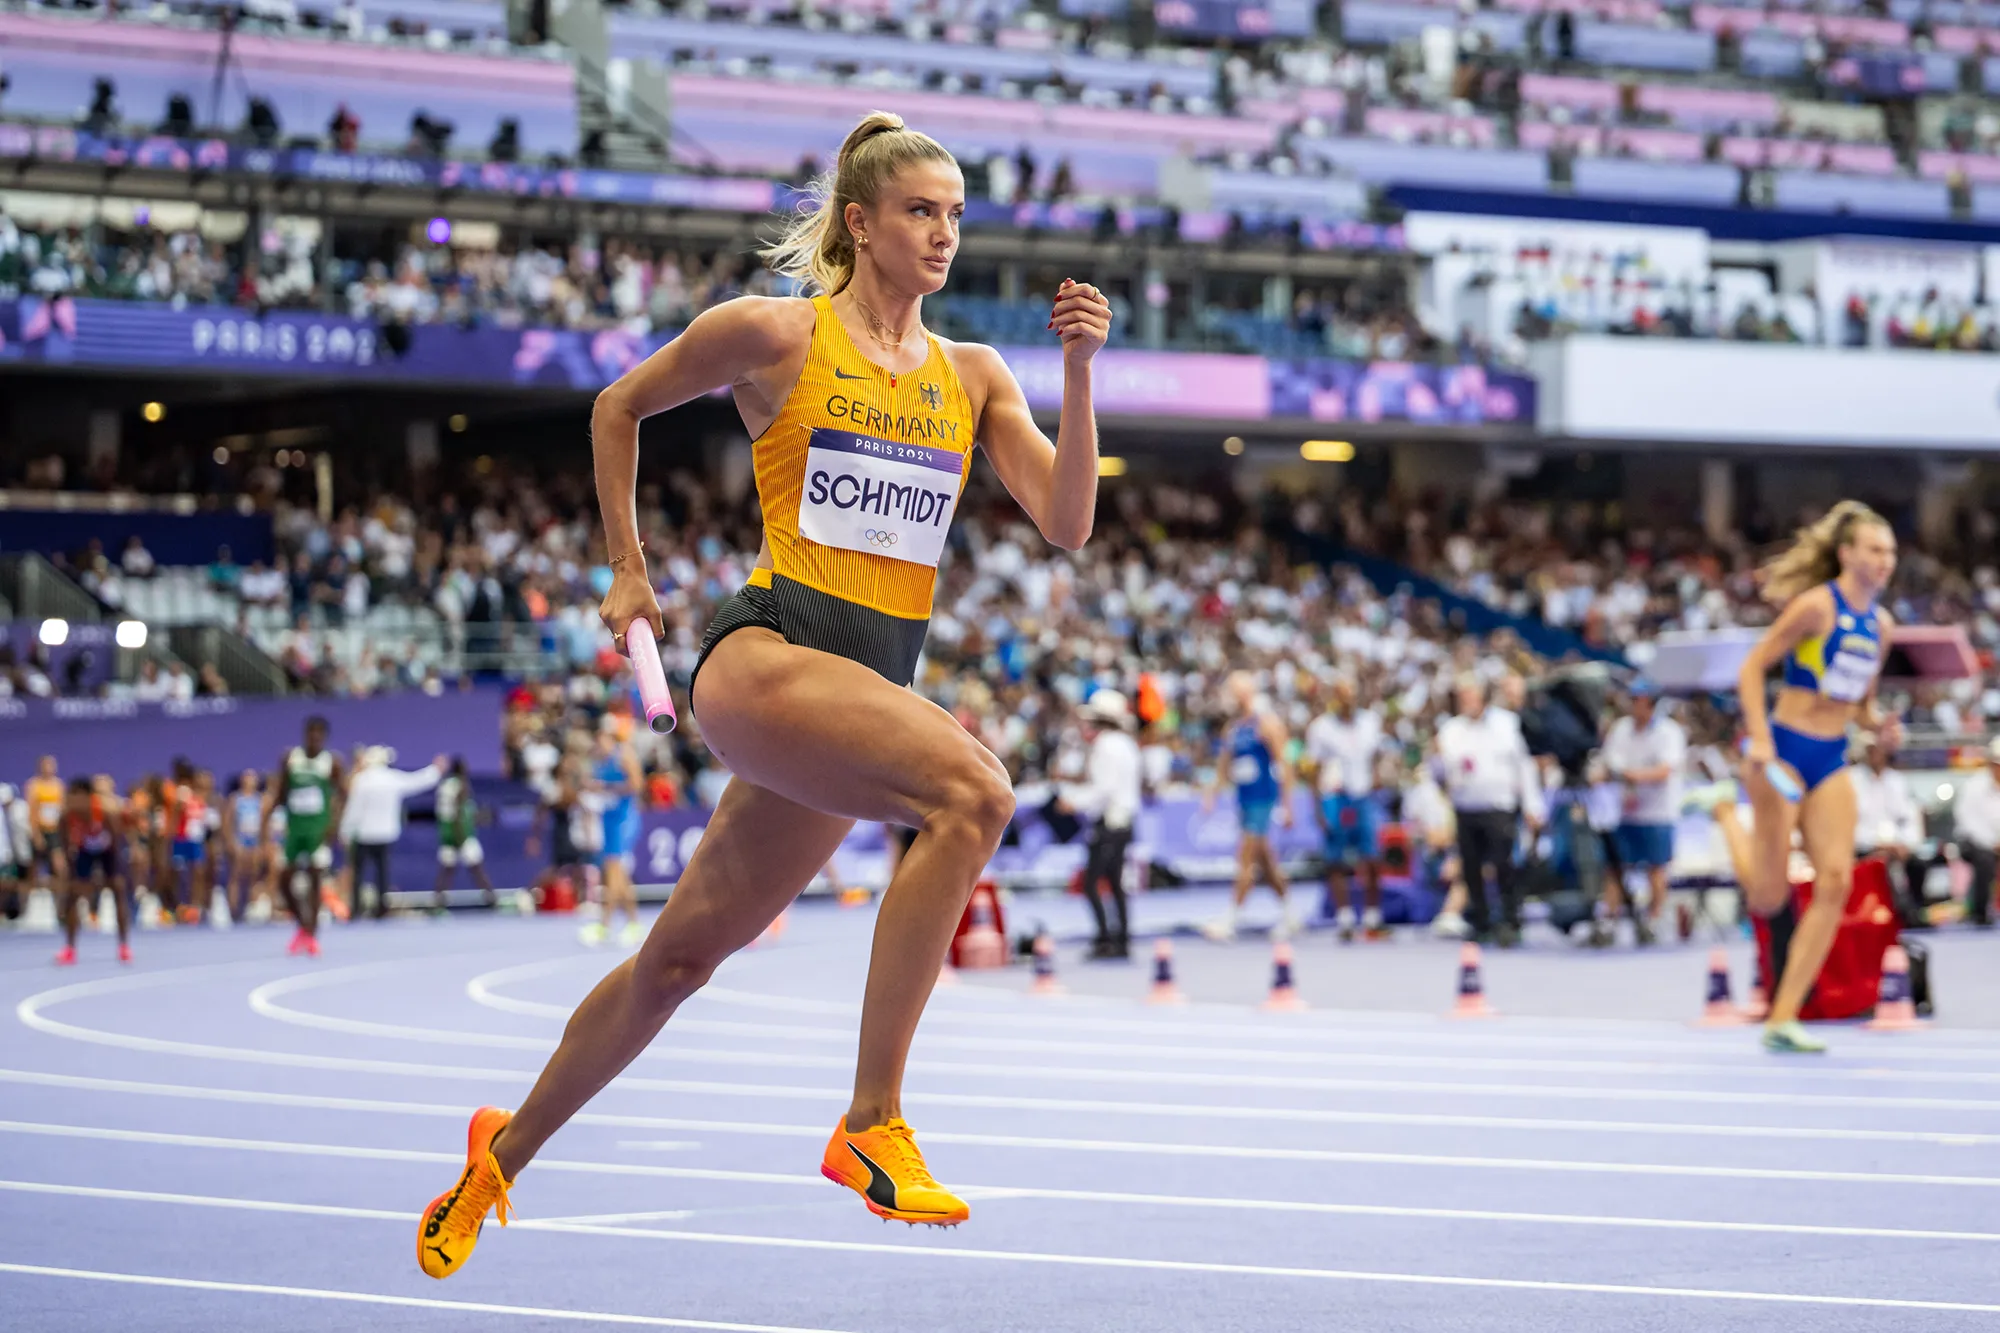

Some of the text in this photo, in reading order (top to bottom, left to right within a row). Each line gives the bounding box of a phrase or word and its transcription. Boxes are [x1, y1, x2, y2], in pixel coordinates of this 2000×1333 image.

[192, 318, 378, 367] PARIS 202
[827, 394, 957, 442] GERMANY
[855, 438, 932, 462] PARIS 2024
[808, 470, 952, 527] SCHMIDT
